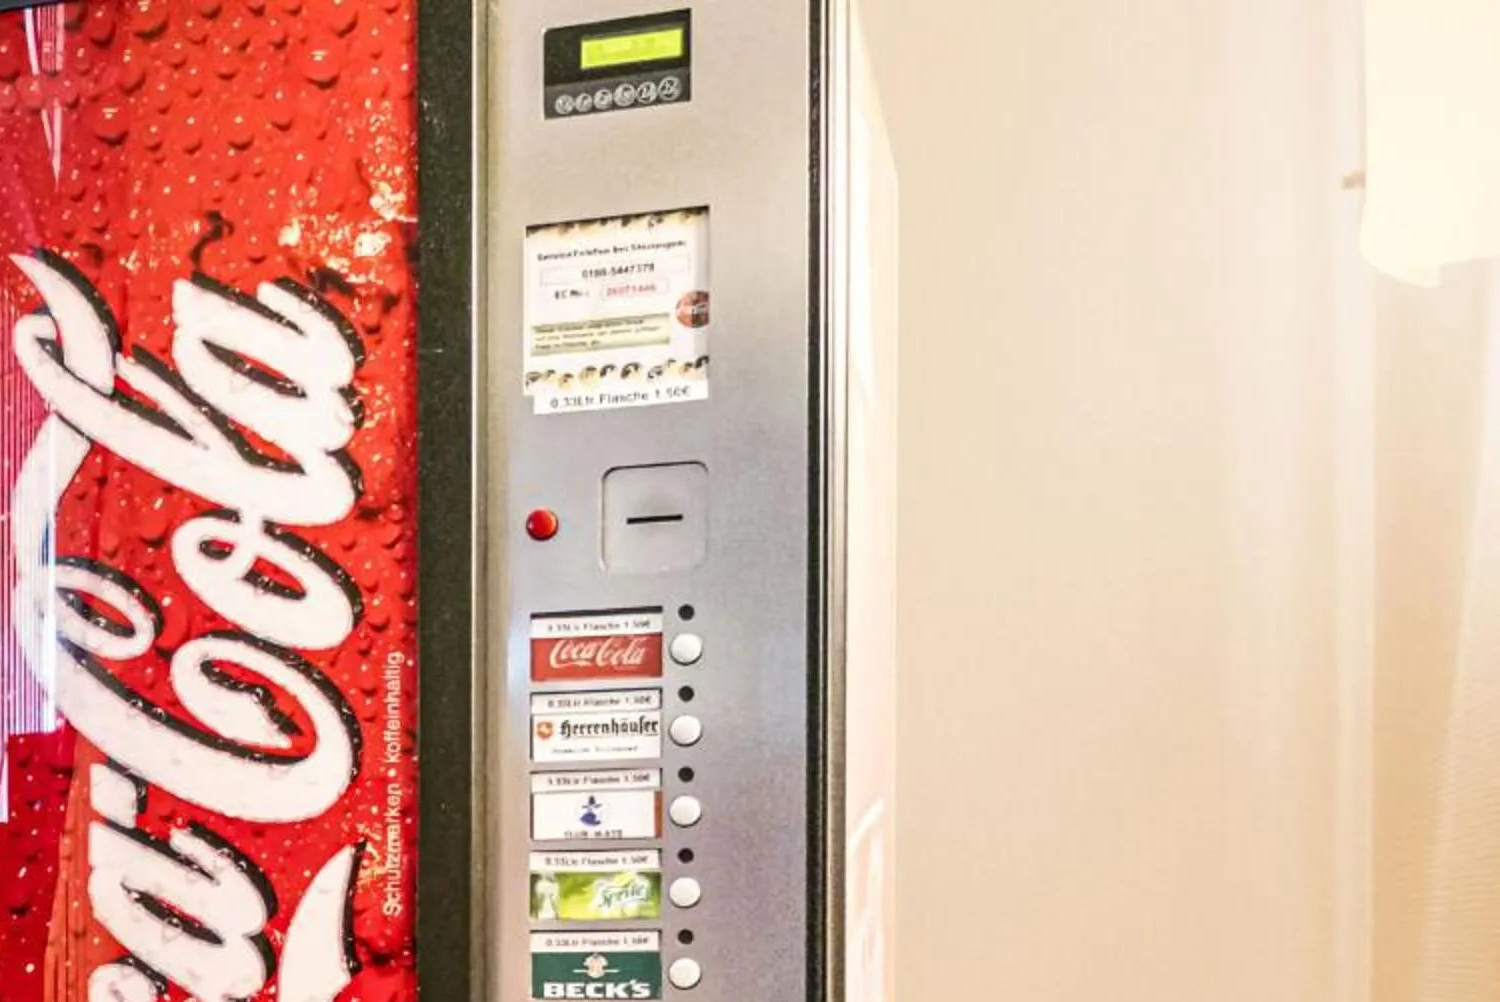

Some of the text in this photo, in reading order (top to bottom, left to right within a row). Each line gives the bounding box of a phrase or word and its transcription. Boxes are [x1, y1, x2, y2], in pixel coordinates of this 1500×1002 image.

[599, 391, 649, 405] Flasche
[549, 636, 648, 669] Coca-Cola
[383, 651, 405, 917] Schutzmarken koffeinhaltig
[543, 979, 651, 999] BECK'S
